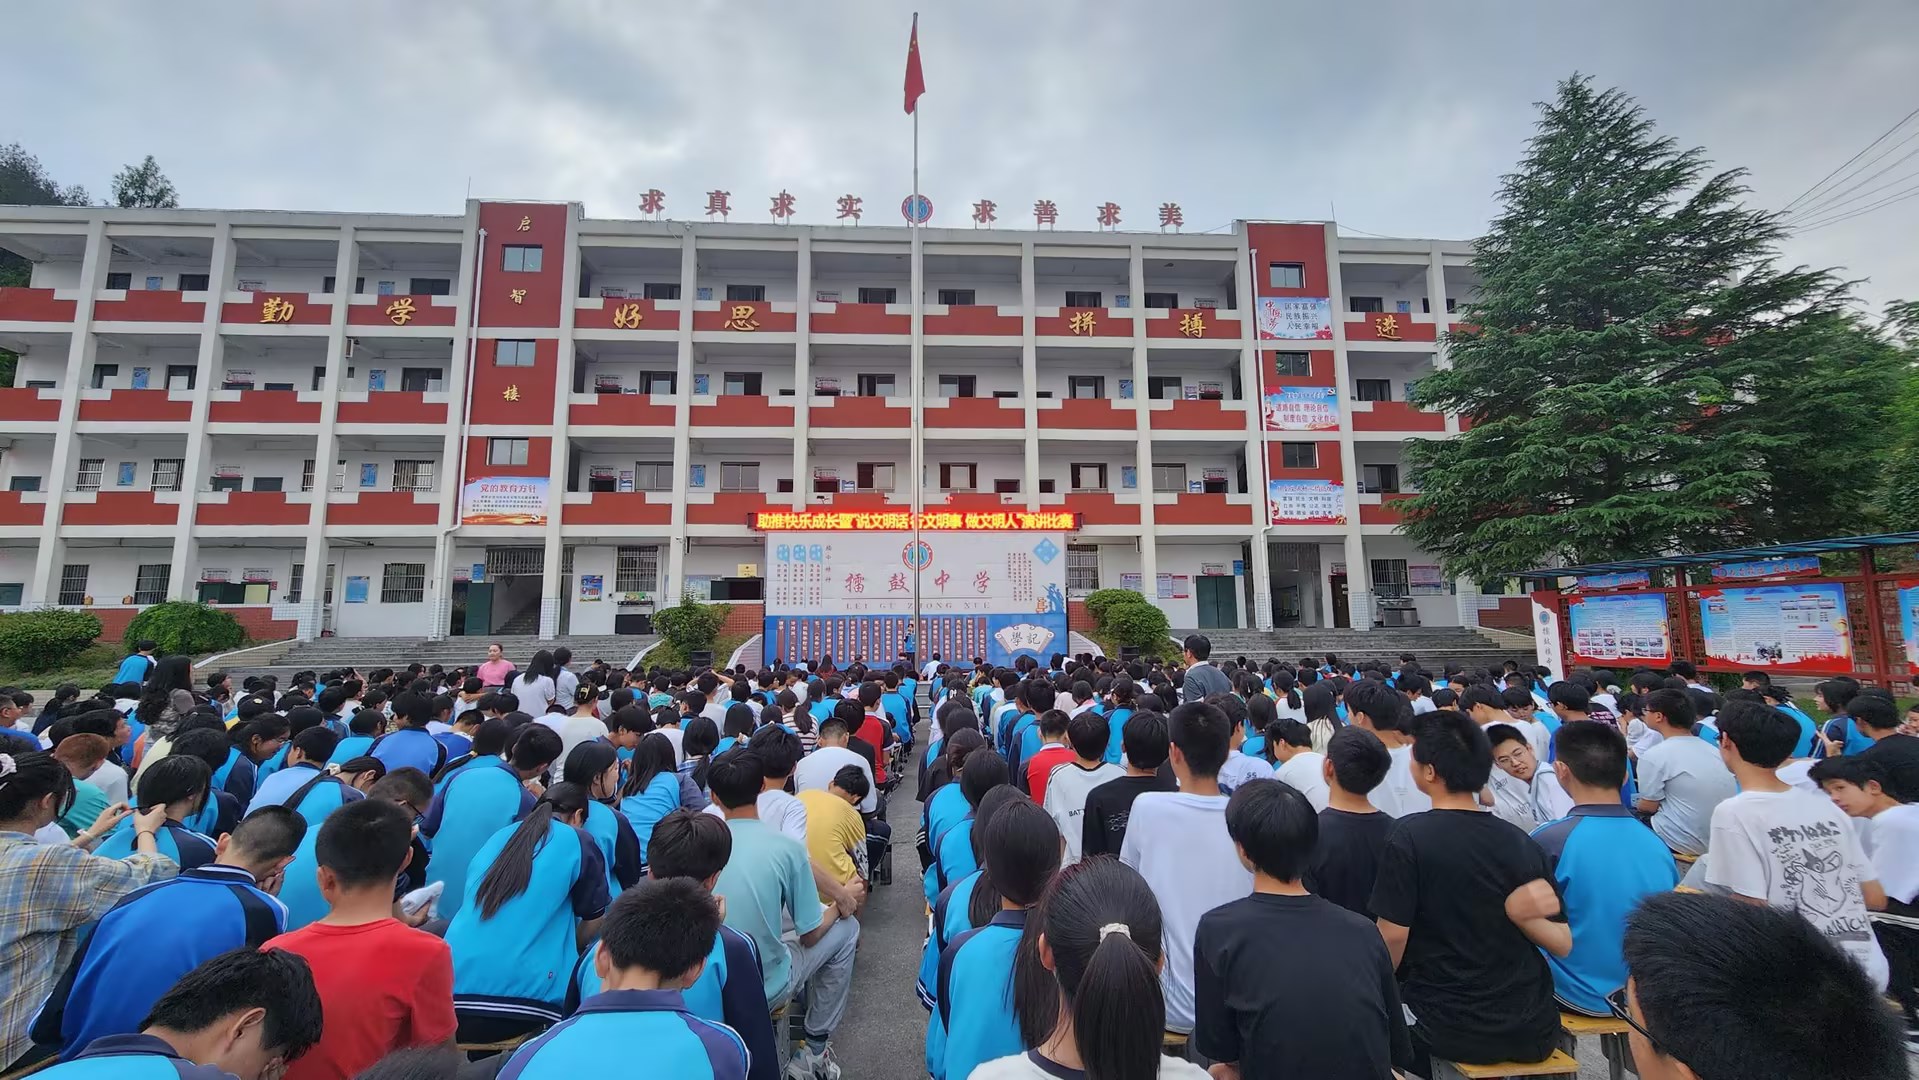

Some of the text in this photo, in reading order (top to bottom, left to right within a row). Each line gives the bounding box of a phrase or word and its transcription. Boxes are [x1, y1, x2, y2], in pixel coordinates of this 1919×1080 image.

[502, 215, 532, 403] 启智楼
[1284, 302, 1318, 311] 国家富强
[1286, 312, 1319, 321] 民族振兴
[1287, 322, 1320, 331] 人民幸福
[480, 483, 537, 494] 党的教育方针
[844, 568, 991, 595] 擂鼓中学
